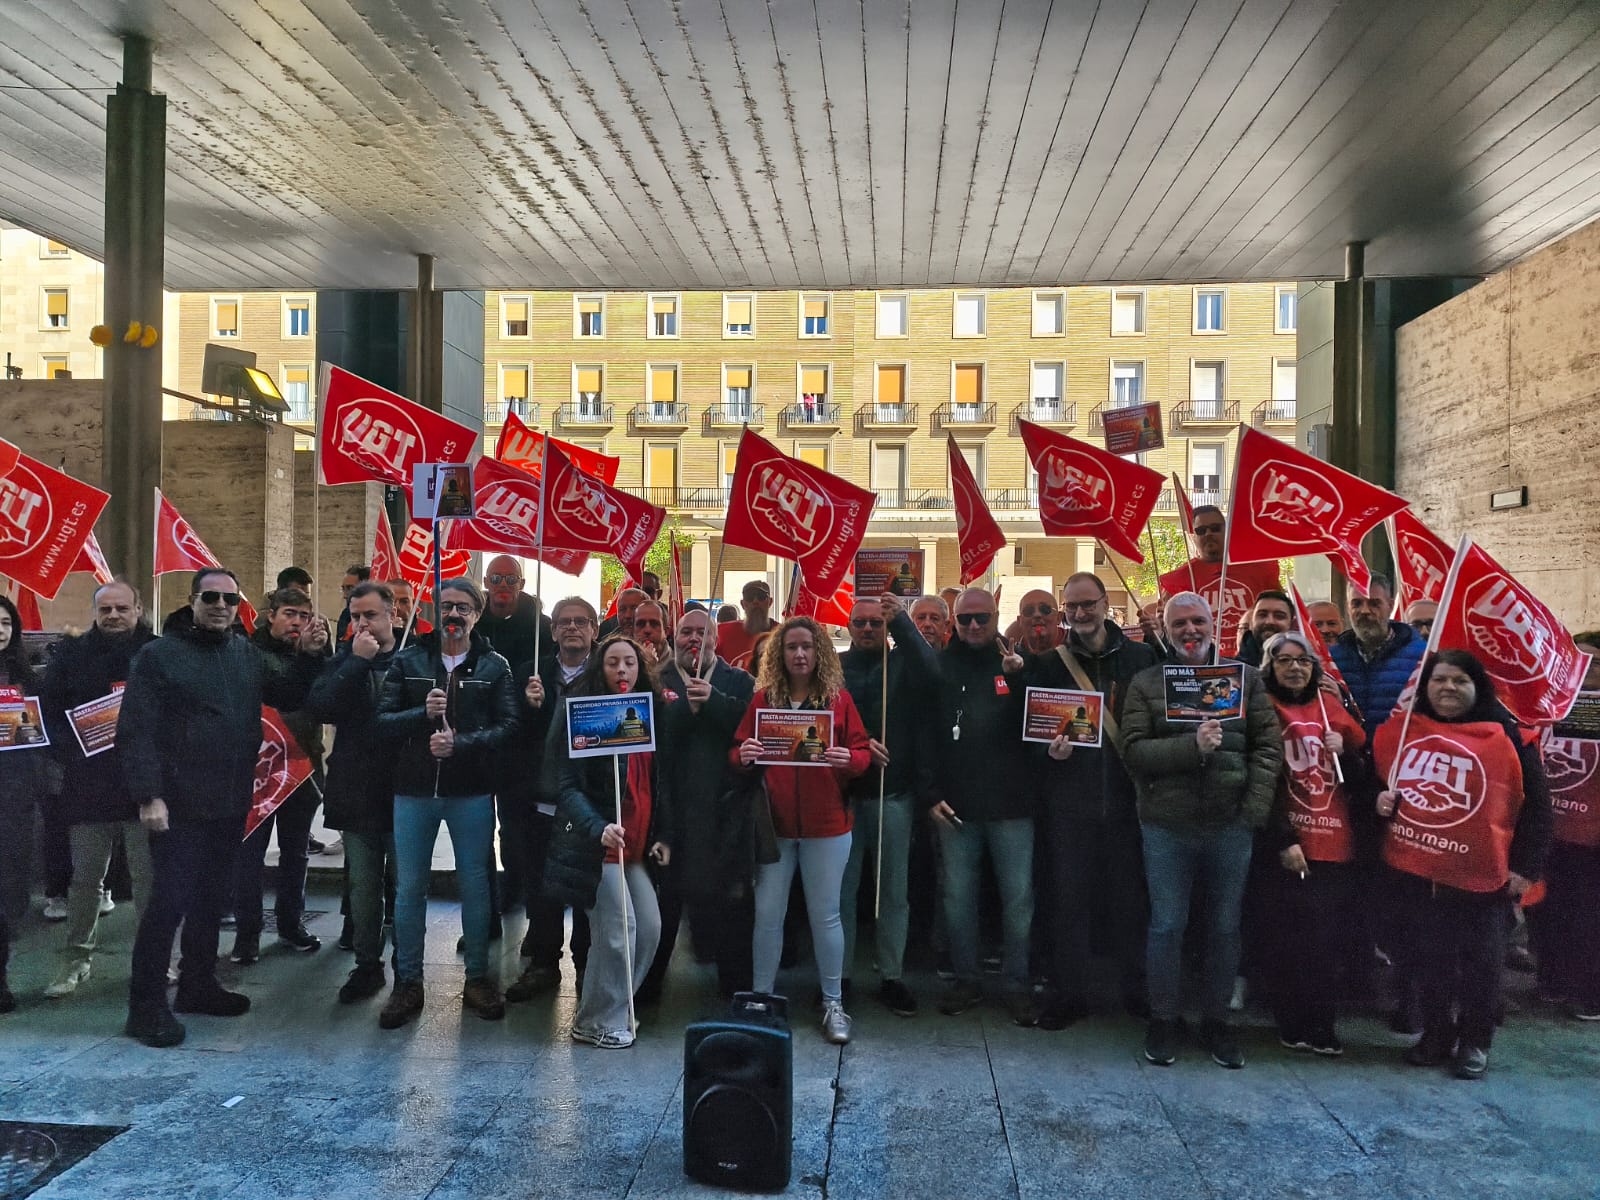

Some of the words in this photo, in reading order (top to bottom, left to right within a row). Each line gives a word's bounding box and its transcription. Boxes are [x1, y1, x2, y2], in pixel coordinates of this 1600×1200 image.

[342, 407, 416, 474] UGT
[0, 477, 43, 530] GT
[481, 486, 538, 528] UG
[760, 467, 824, 530] UGT
[38, 500, 87, 579] www.ugt.es
[817, 501, 861, 580] www.ugt.es
[1402, 536, 1444, 600] GT
[1166, 668, 1178, 676] ¡NO
[1178, 667, 1195, 676] MÁS
[1399, 747, 1473, 794] UGT
[1288, 811, 1312, 825] ano
[1391, 823, 1414, 838] ano
[1421, 832, 1469, 855] mano
